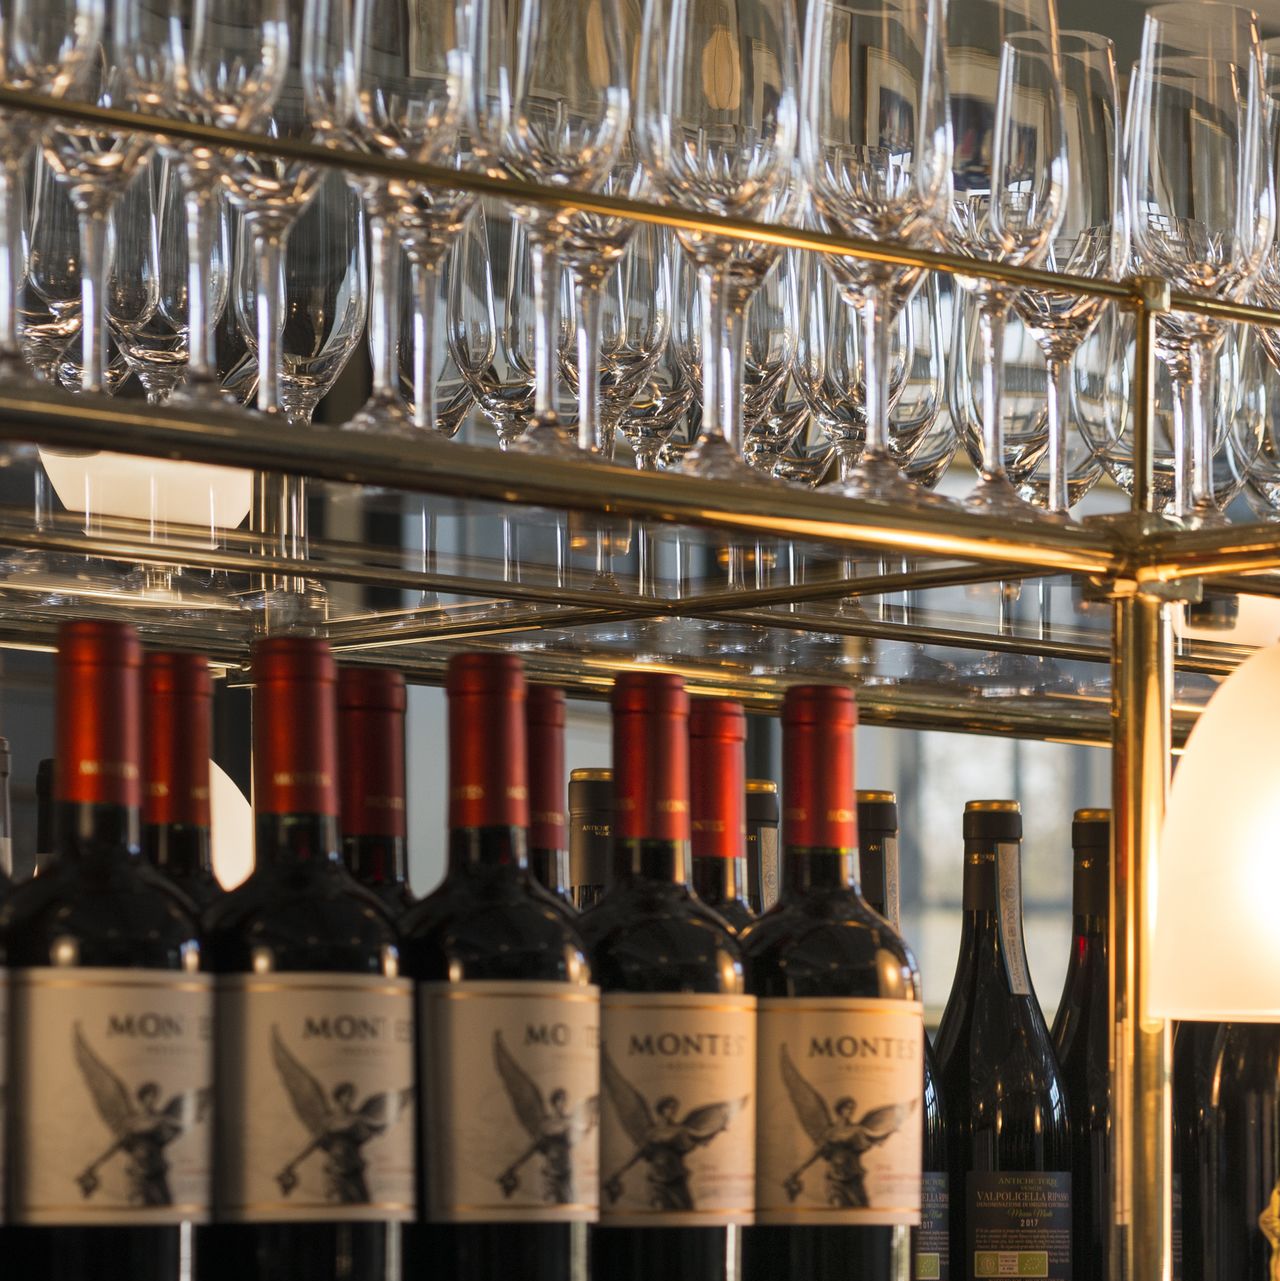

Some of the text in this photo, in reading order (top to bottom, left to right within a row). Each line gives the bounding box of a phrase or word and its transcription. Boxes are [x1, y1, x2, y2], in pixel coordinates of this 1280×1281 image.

[628, 1032, 747, 1057] MONTES
[809, 1035, 917, 1060] MONTES
[977, 1191, 1046, 1201] VALPOLICELLA
[1020, 1219, 1039, 1227] 2017
